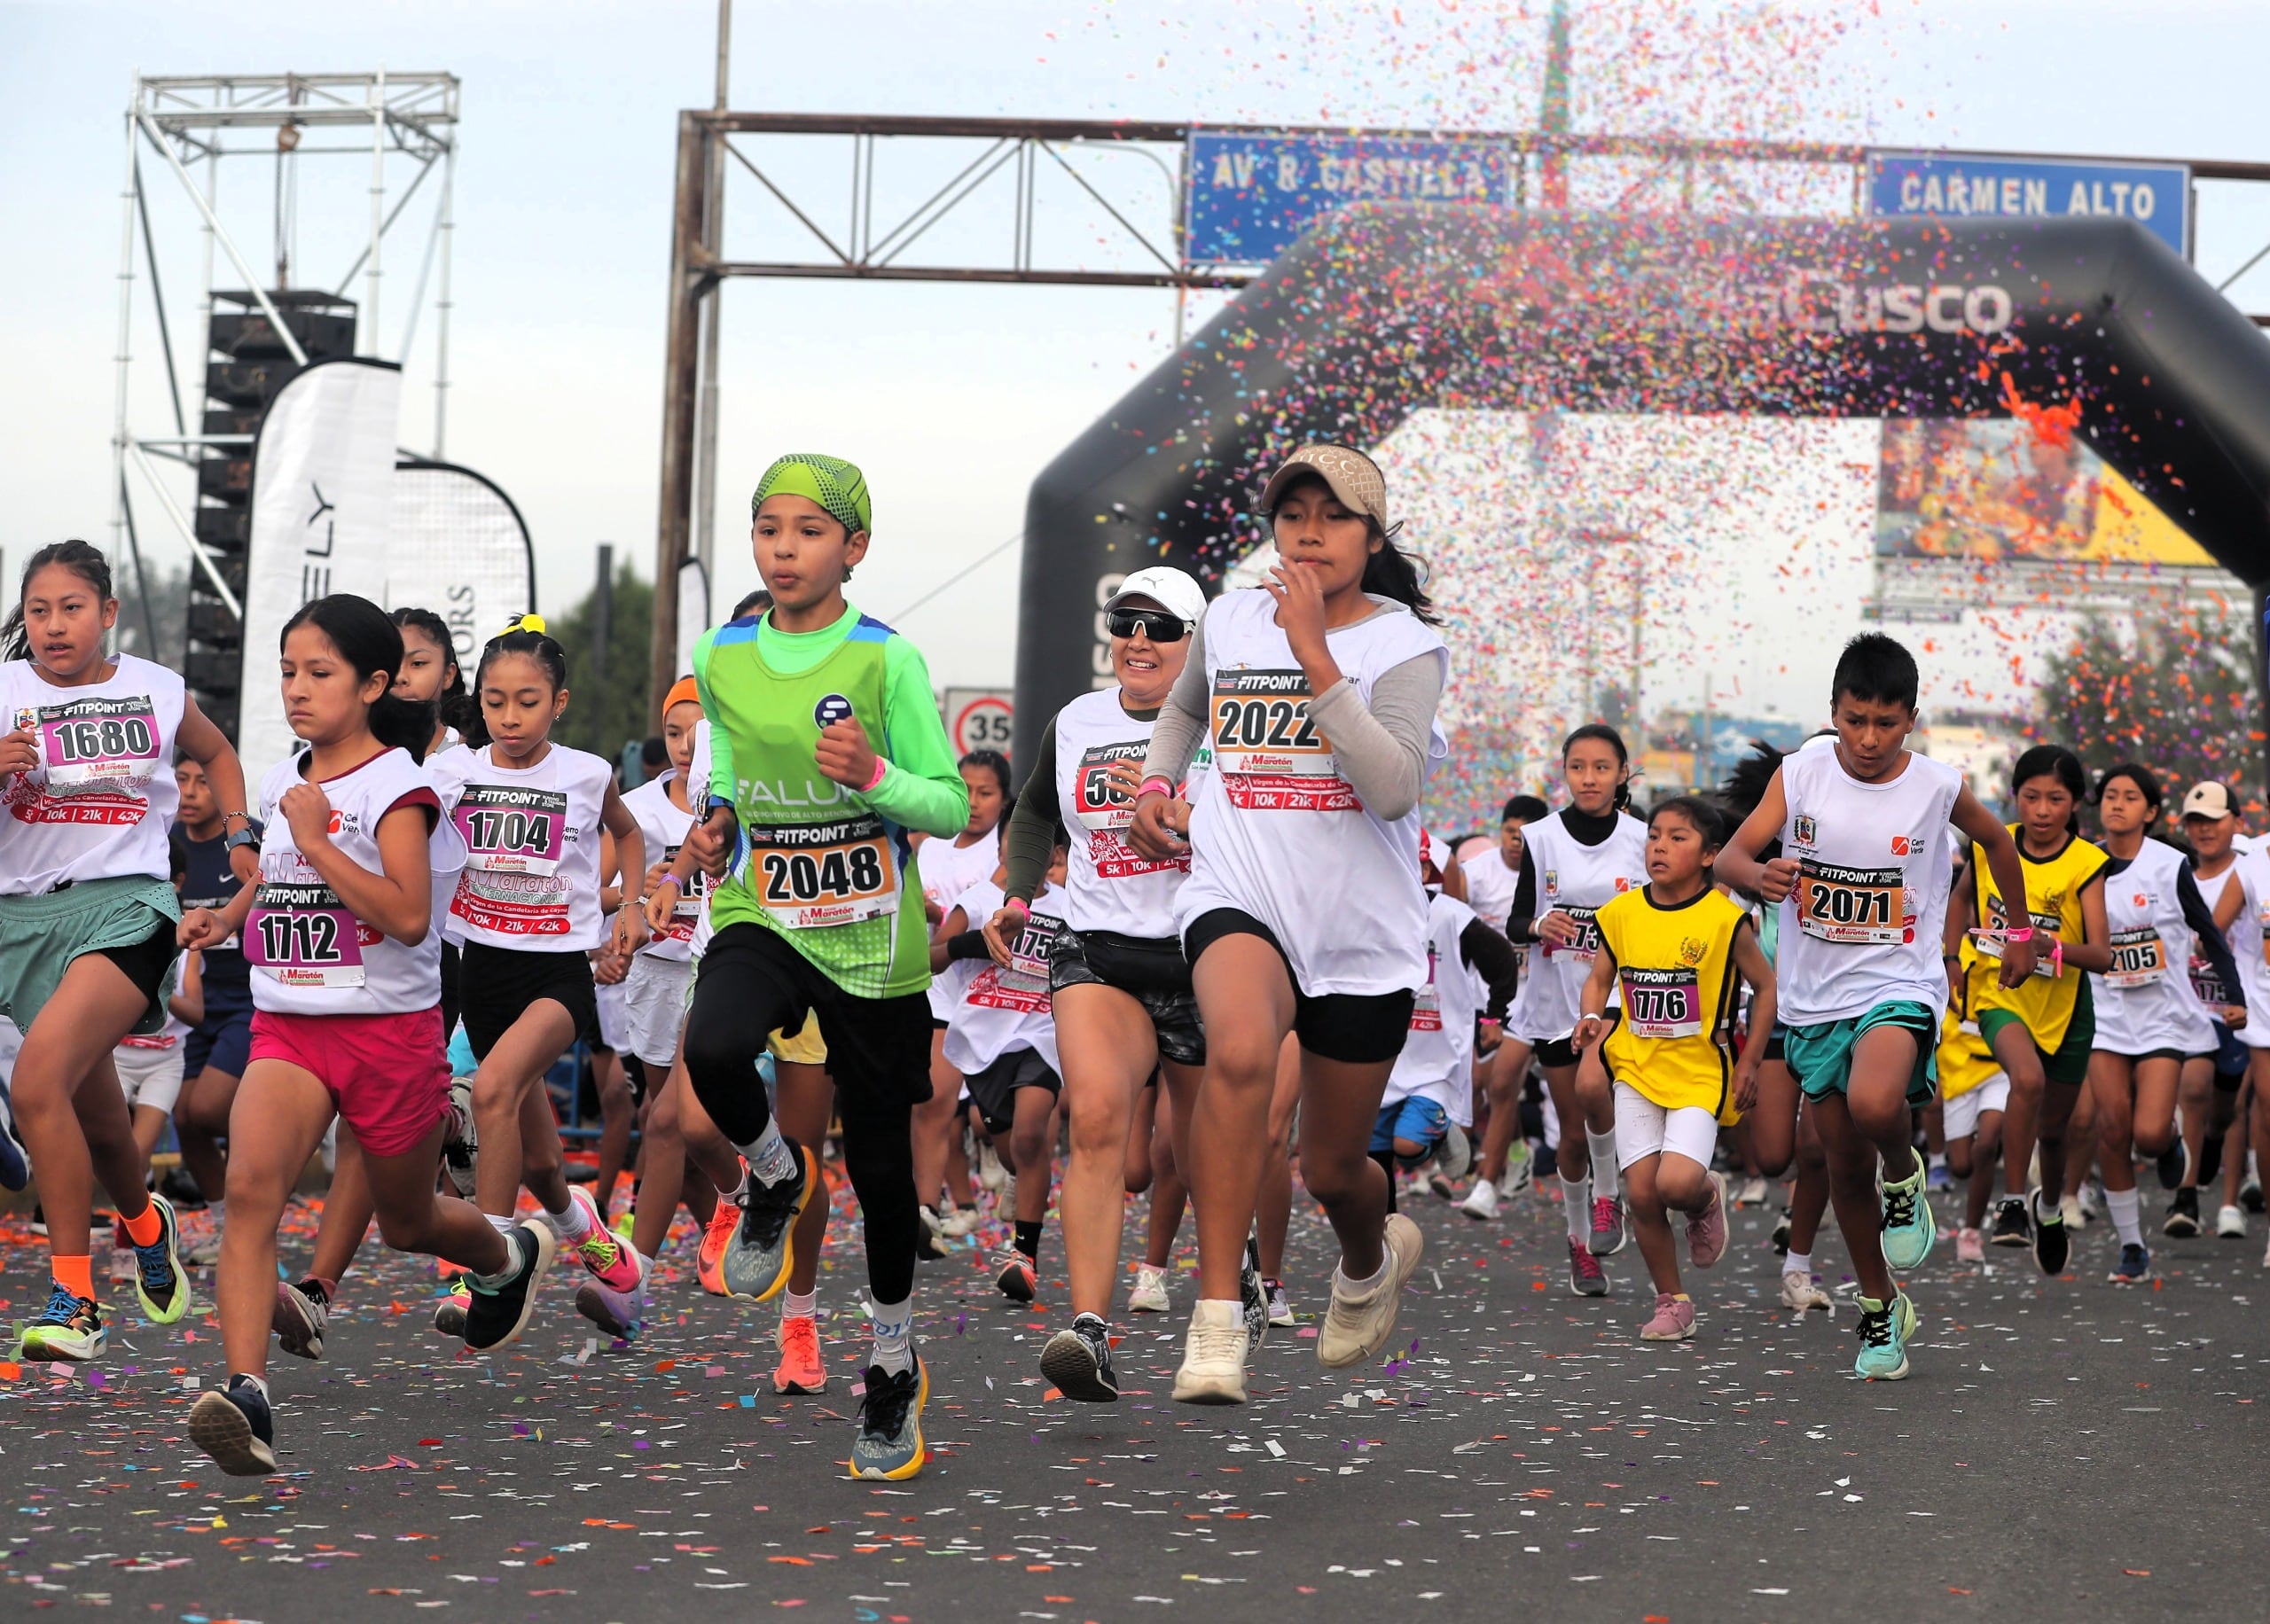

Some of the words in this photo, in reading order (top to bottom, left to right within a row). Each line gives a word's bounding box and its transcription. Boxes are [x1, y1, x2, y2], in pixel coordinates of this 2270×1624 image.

[1212, 152, 1256, 189] AV
[1278, 153, 1298, 192] R
[1901, 174, 2047, 216] CARMEN
[2068, 181, 2156, 220] ALTO
[1238, 675, 1303, 690] FITPOINT
[64, 702, 124, 716] FITPOINT
[969, 714, 1010, 744] 35
[1217, 699, 1321, 748] 2022
[53, 718, 152, 761] 1680
[1103, 744, 1150, 760] FITPOIN
[1252, 755, 1292, 765] Maratón
[478, 791, 540, 806] FITPOINT
[1255, 794, 1277, 806] 10k
[1289, 794, 1312, 807] 21k
[1326, 795, 1353, 808] 42k
[47, 810, 67, 820] 10k
[82, 811, 102, 821] 21k
[117, 812, 142, 821] 42k
[466, 809, 551, 855] 1704
[775, 824, 849, 843] FITPOINT
[495, 855, 527, 865] Maratón
[763, 844, 885, 902] 2048
[1106, 864, 1120, 874] 5k
[1819, 867, 1878, 883] FITPOINT
[266, 889, 320, 903] FITPOINT
[1811, 883, 1890, 924] 2071
[504, 905, 539, 914] Candelaria
[810, 907, 854, 918] Maratón
[505, 922, 525, 932] 21k
[538, 921, 560, 931] 42k
[1836, 927, 1869, 936] Maratón
[258, 914, 340, 963] 1712
[287, 969, 324, 979] Maratón
[1002, 999, 1017, 1008] 10k
[1632, 988, 1687, 1021] 1776
